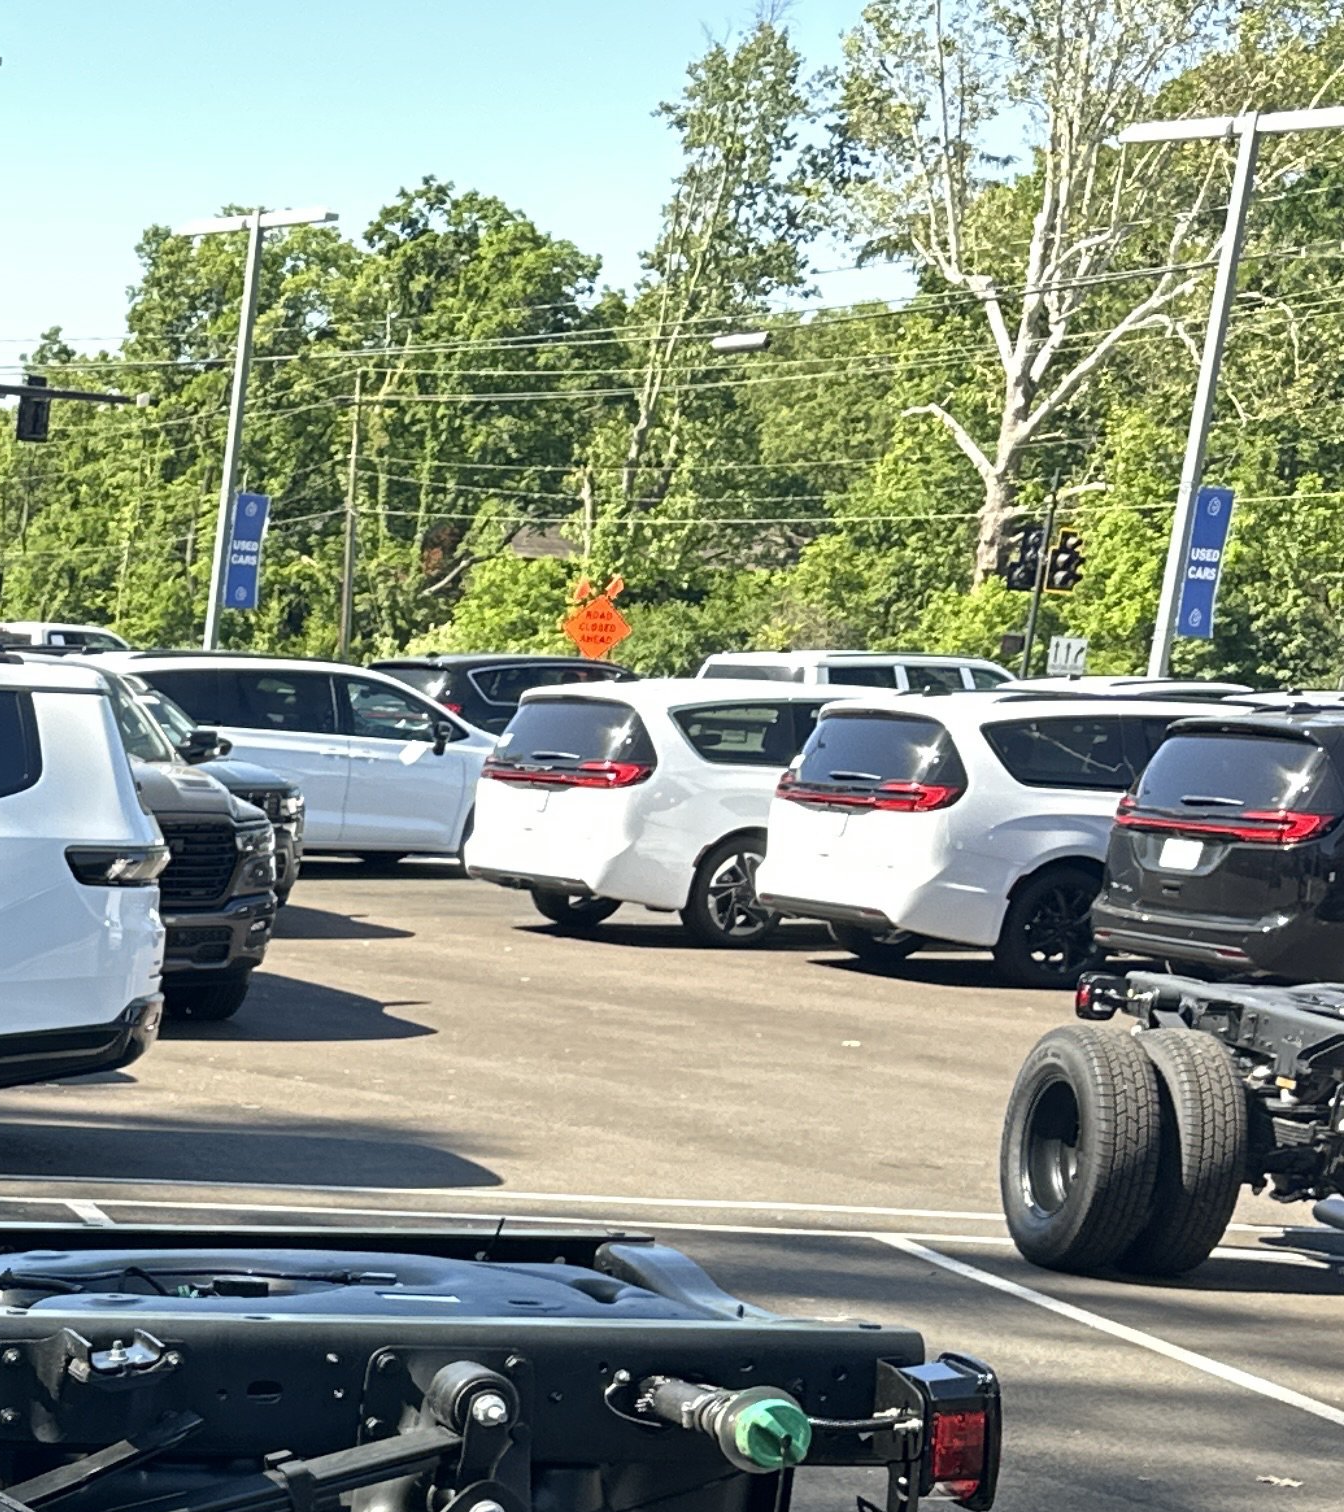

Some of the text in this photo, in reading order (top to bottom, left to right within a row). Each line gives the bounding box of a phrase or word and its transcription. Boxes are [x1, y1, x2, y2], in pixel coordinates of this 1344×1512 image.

[233, 540, 258, 551] USED
[231, 553, 257, 566] CARS
[1191, 548, 1220, 562] USED
[1188, 565, 1217, 580] CARS
[586, 611, 613, 620] ROAD
[579, 622, 616, 632] CLOSED
